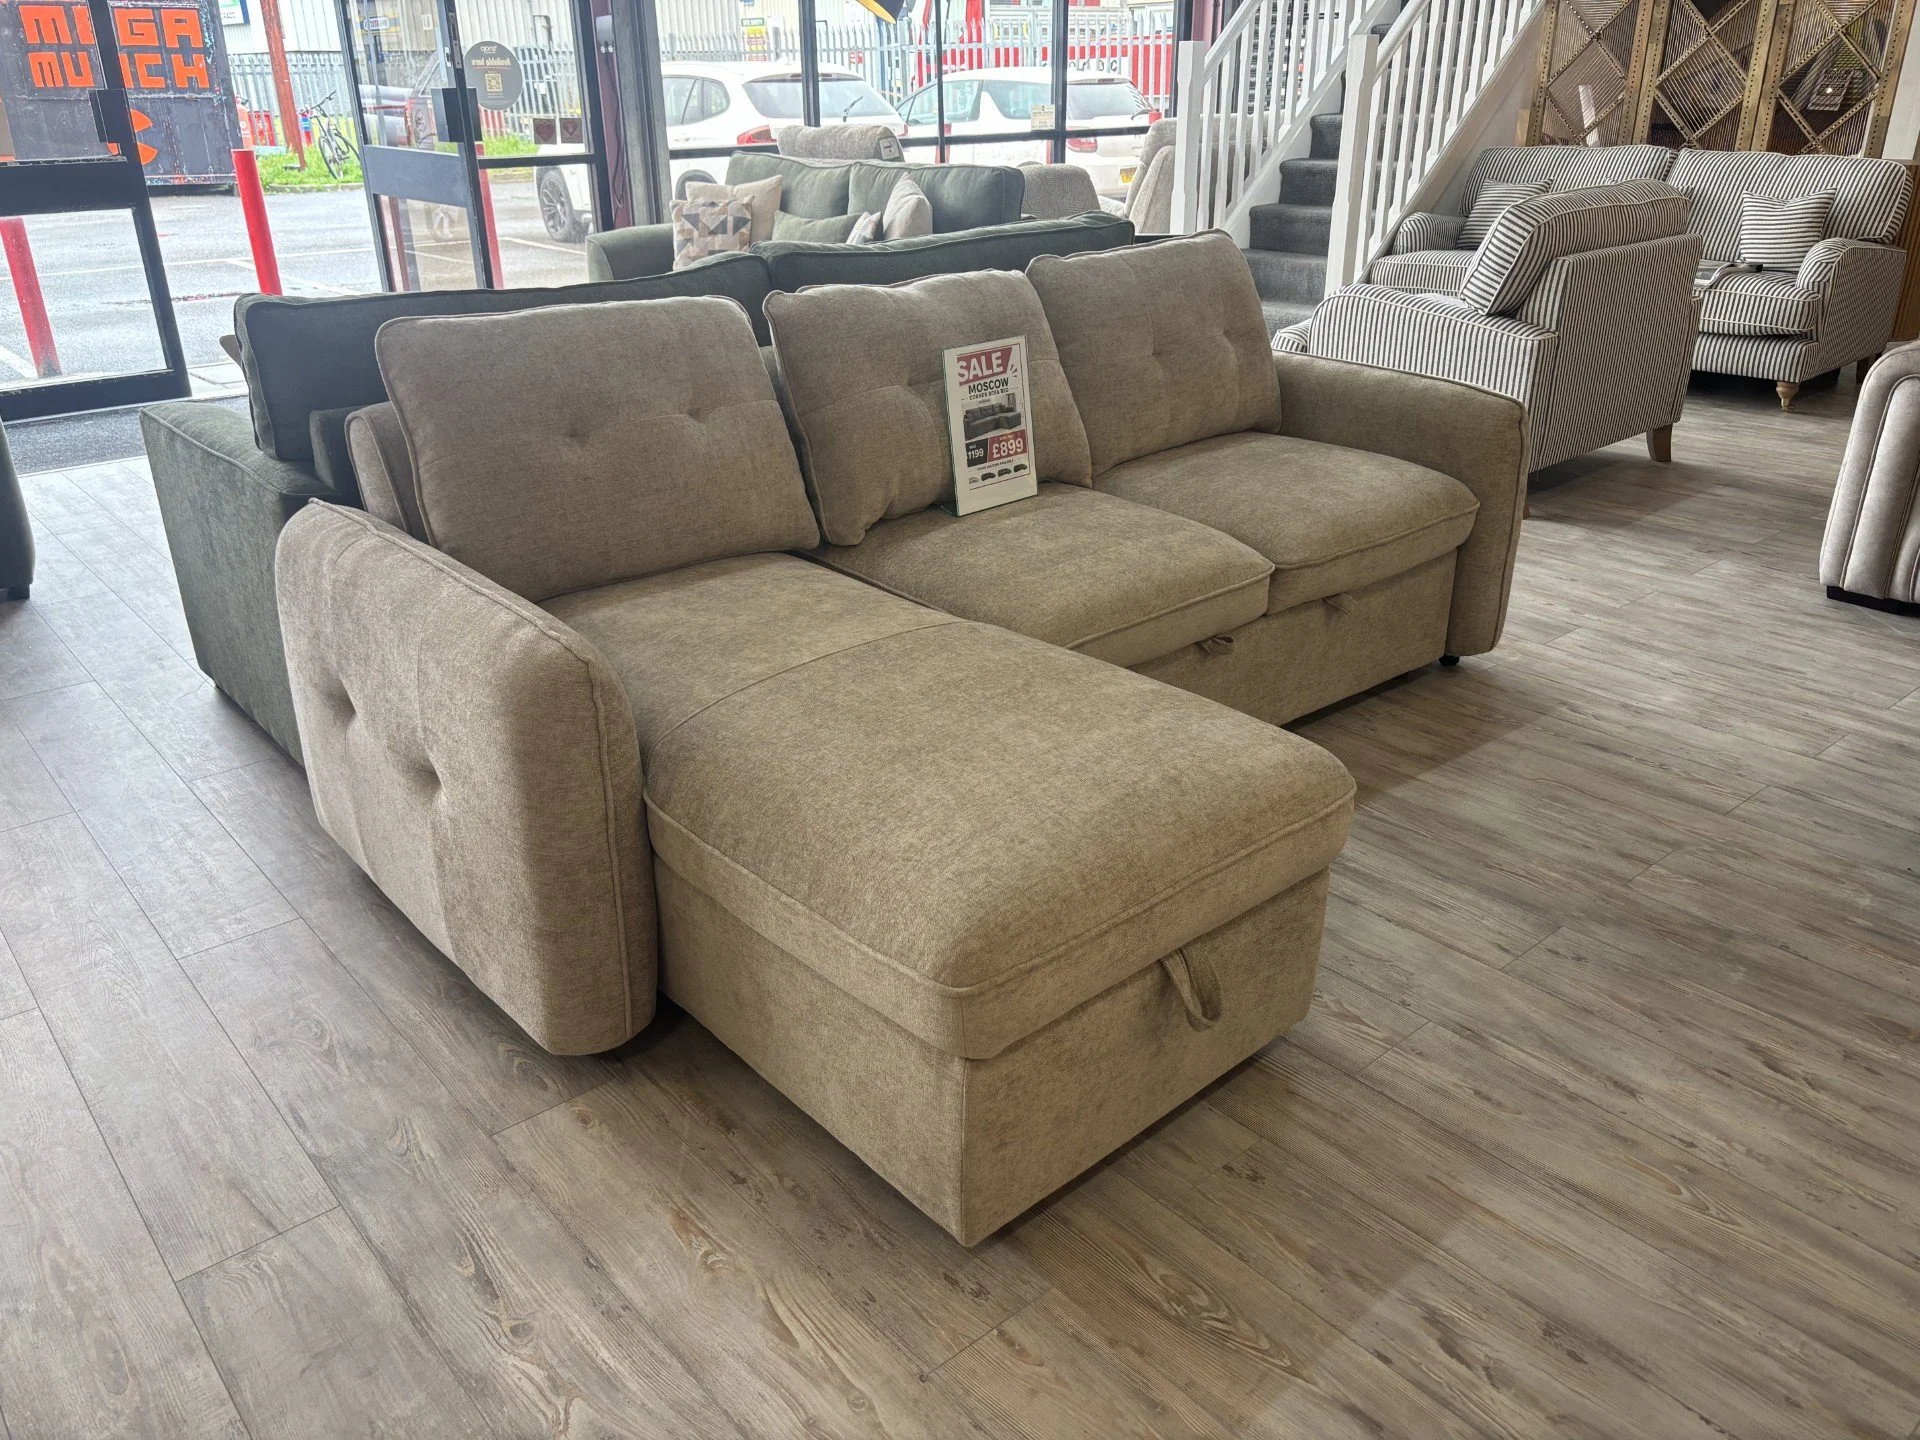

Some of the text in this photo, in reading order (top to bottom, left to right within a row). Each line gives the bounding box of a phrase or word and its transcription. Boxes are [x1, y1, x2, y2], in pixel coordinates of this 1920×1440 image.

[957, 351, 1004, 383] SALE
[968, 377, 1009, 394] MOSCOW
[992, 437, 1024, 459] £899
